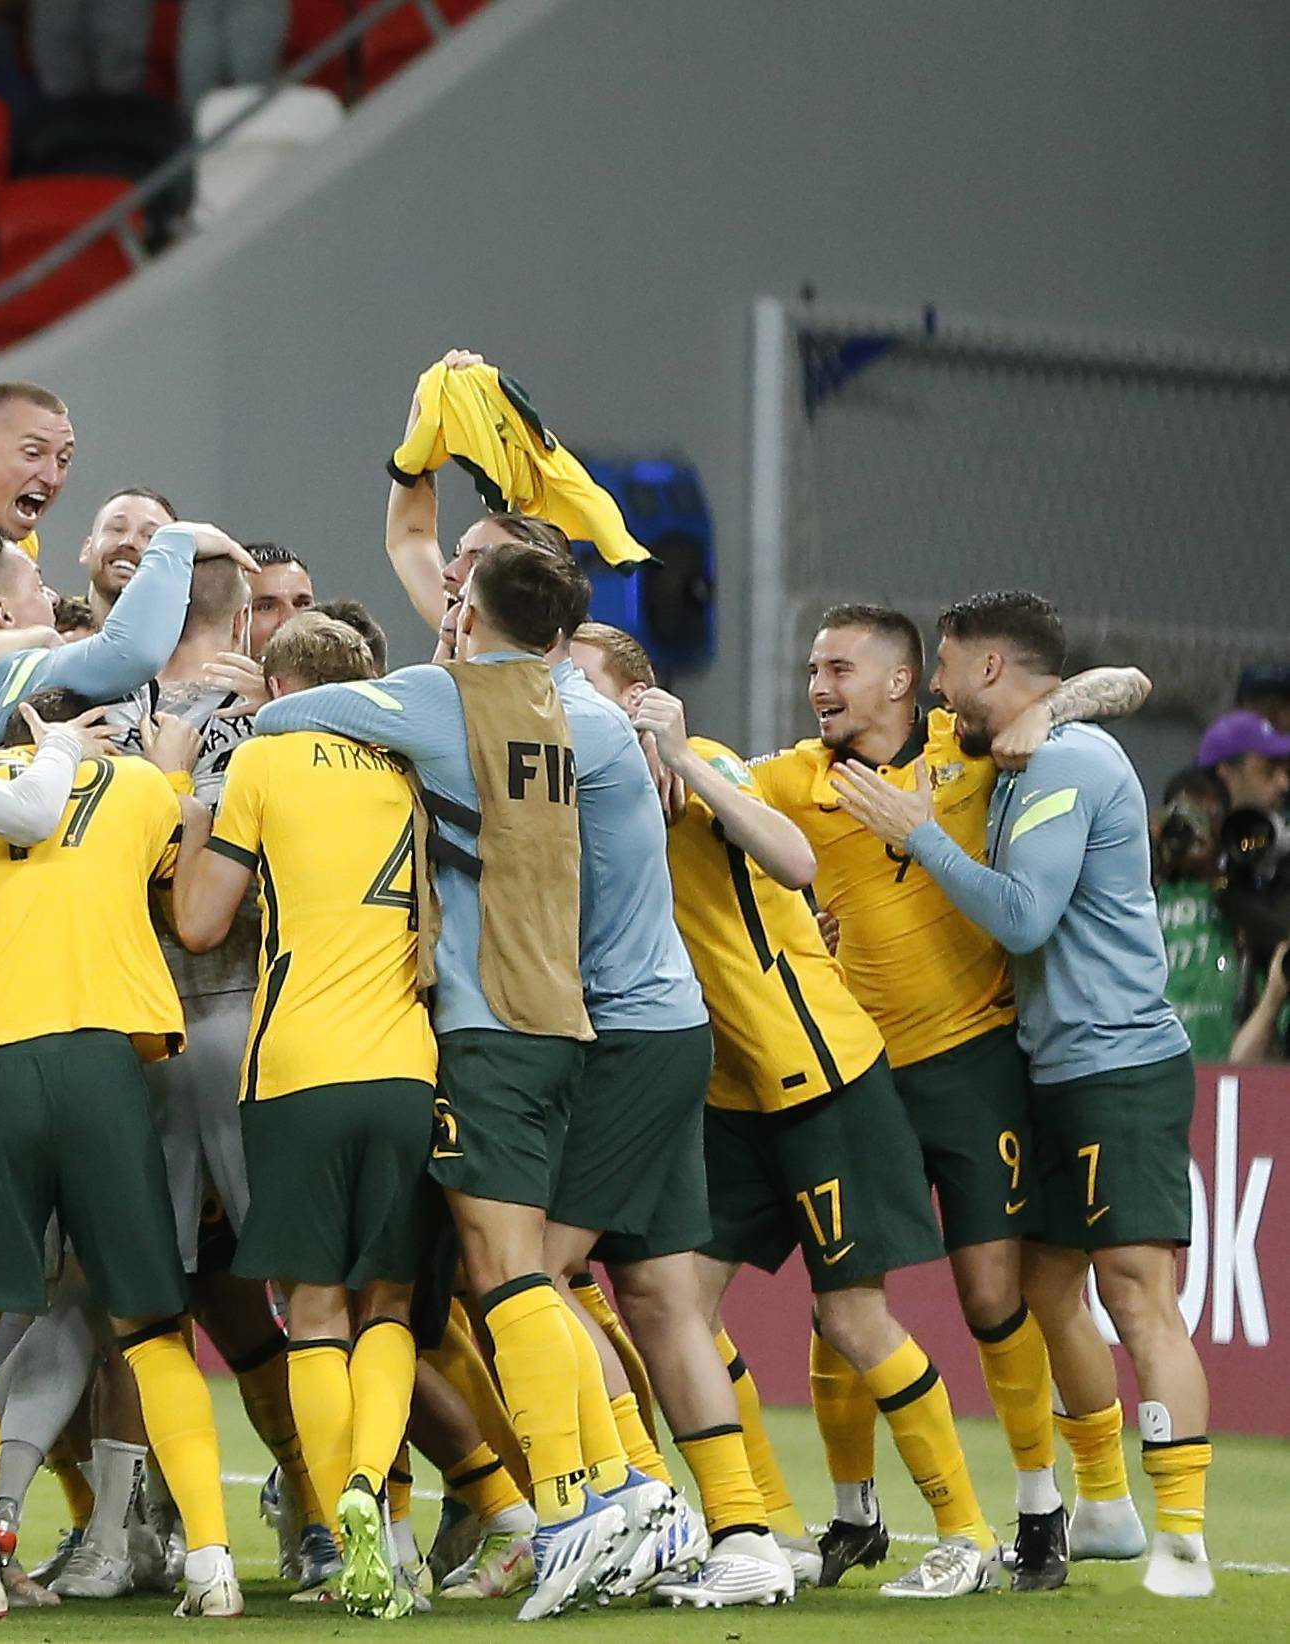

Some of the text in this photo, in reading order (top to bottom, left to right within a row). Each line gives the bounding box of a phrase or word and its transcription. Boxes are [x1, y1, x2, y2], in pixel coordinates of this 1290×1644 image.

[360, 808, 419, 932] 4
[998, 1129, 1021, 1190] 9
[1077, 1143, 1100, 1207] 7
[796, 1177, 843, 1247] 17
